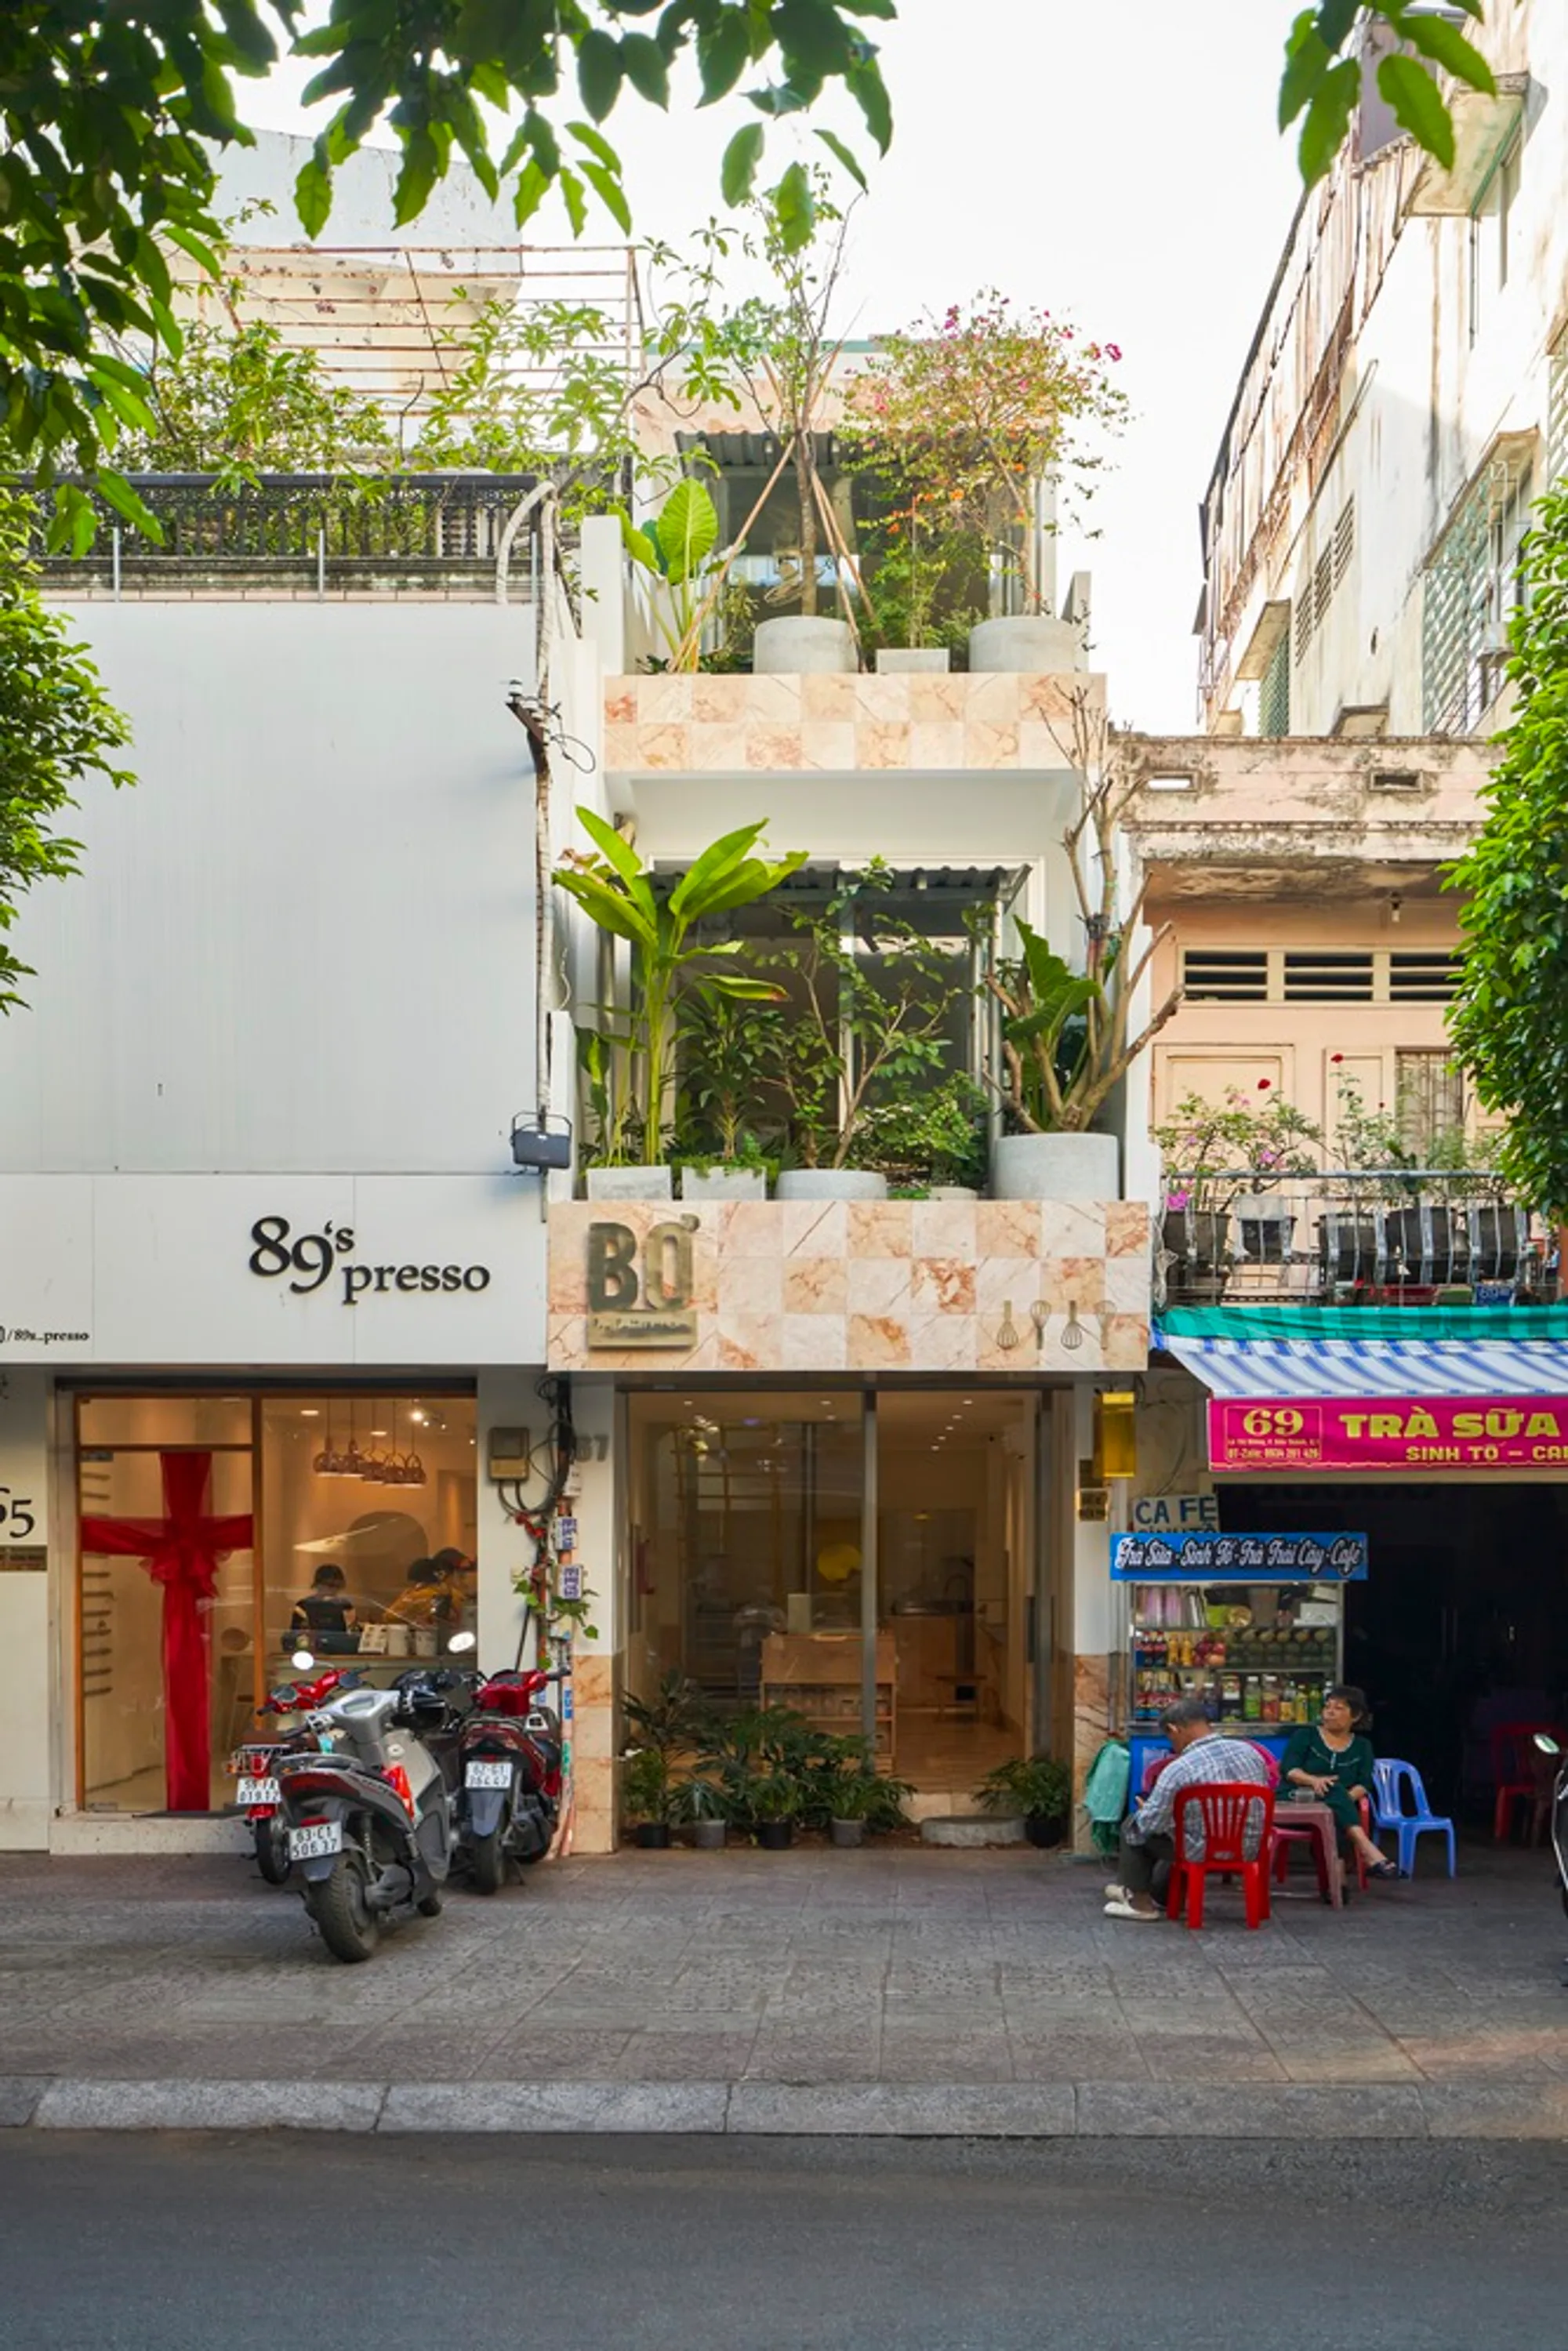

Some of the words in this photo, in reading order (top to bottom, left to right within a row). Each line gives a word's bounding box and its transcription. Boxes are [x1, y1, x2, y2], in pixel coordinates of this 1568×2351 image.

[342, 1264, 491, 1306] presso
[1243, 1408, 1304, 1436] 69
[1339, 1406, 1439, 1439] TRÀ
[1451, 1408, 1561, 1438] SỮA
[1406, 1446, 1460, 1461] SINH
[1533, 1446, 1568, 1461] CA
